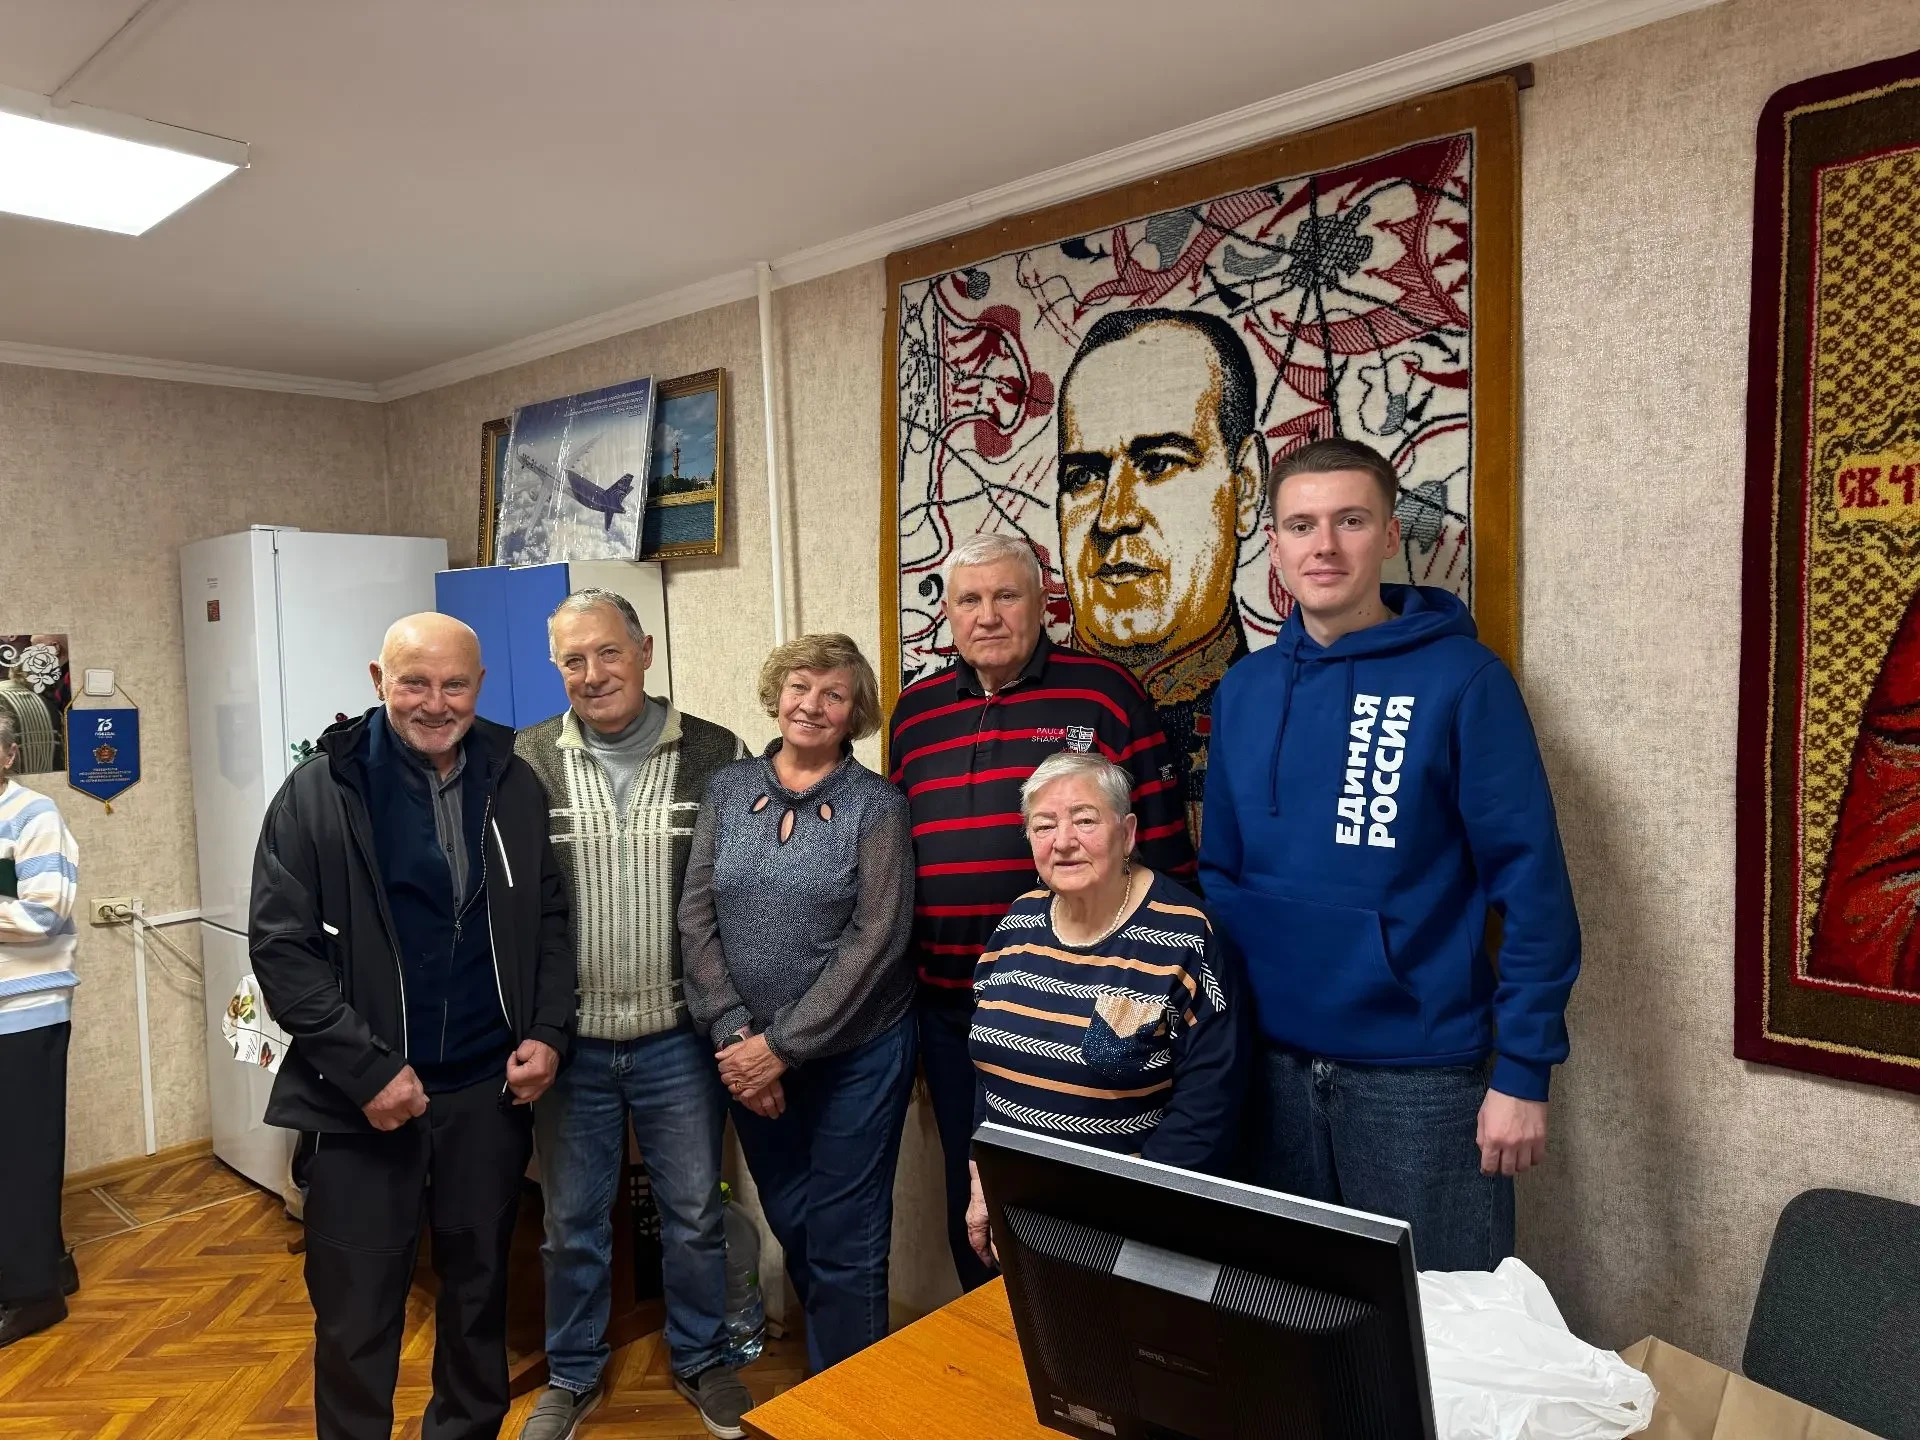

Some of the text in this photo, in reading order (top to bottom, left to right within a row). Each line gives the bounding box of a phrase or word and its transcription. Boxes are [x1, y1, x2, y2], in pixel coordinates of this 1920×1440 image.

[97, 718, 112, 731] 75
[1031, 735, 1060, 743] SHARK
[1335, 693, 1381, 845] ЕДИНАЯ
[1367, 696, 1415, 848] РОССИЯ
[1139, 1348, 1168, 1364] BenQ
